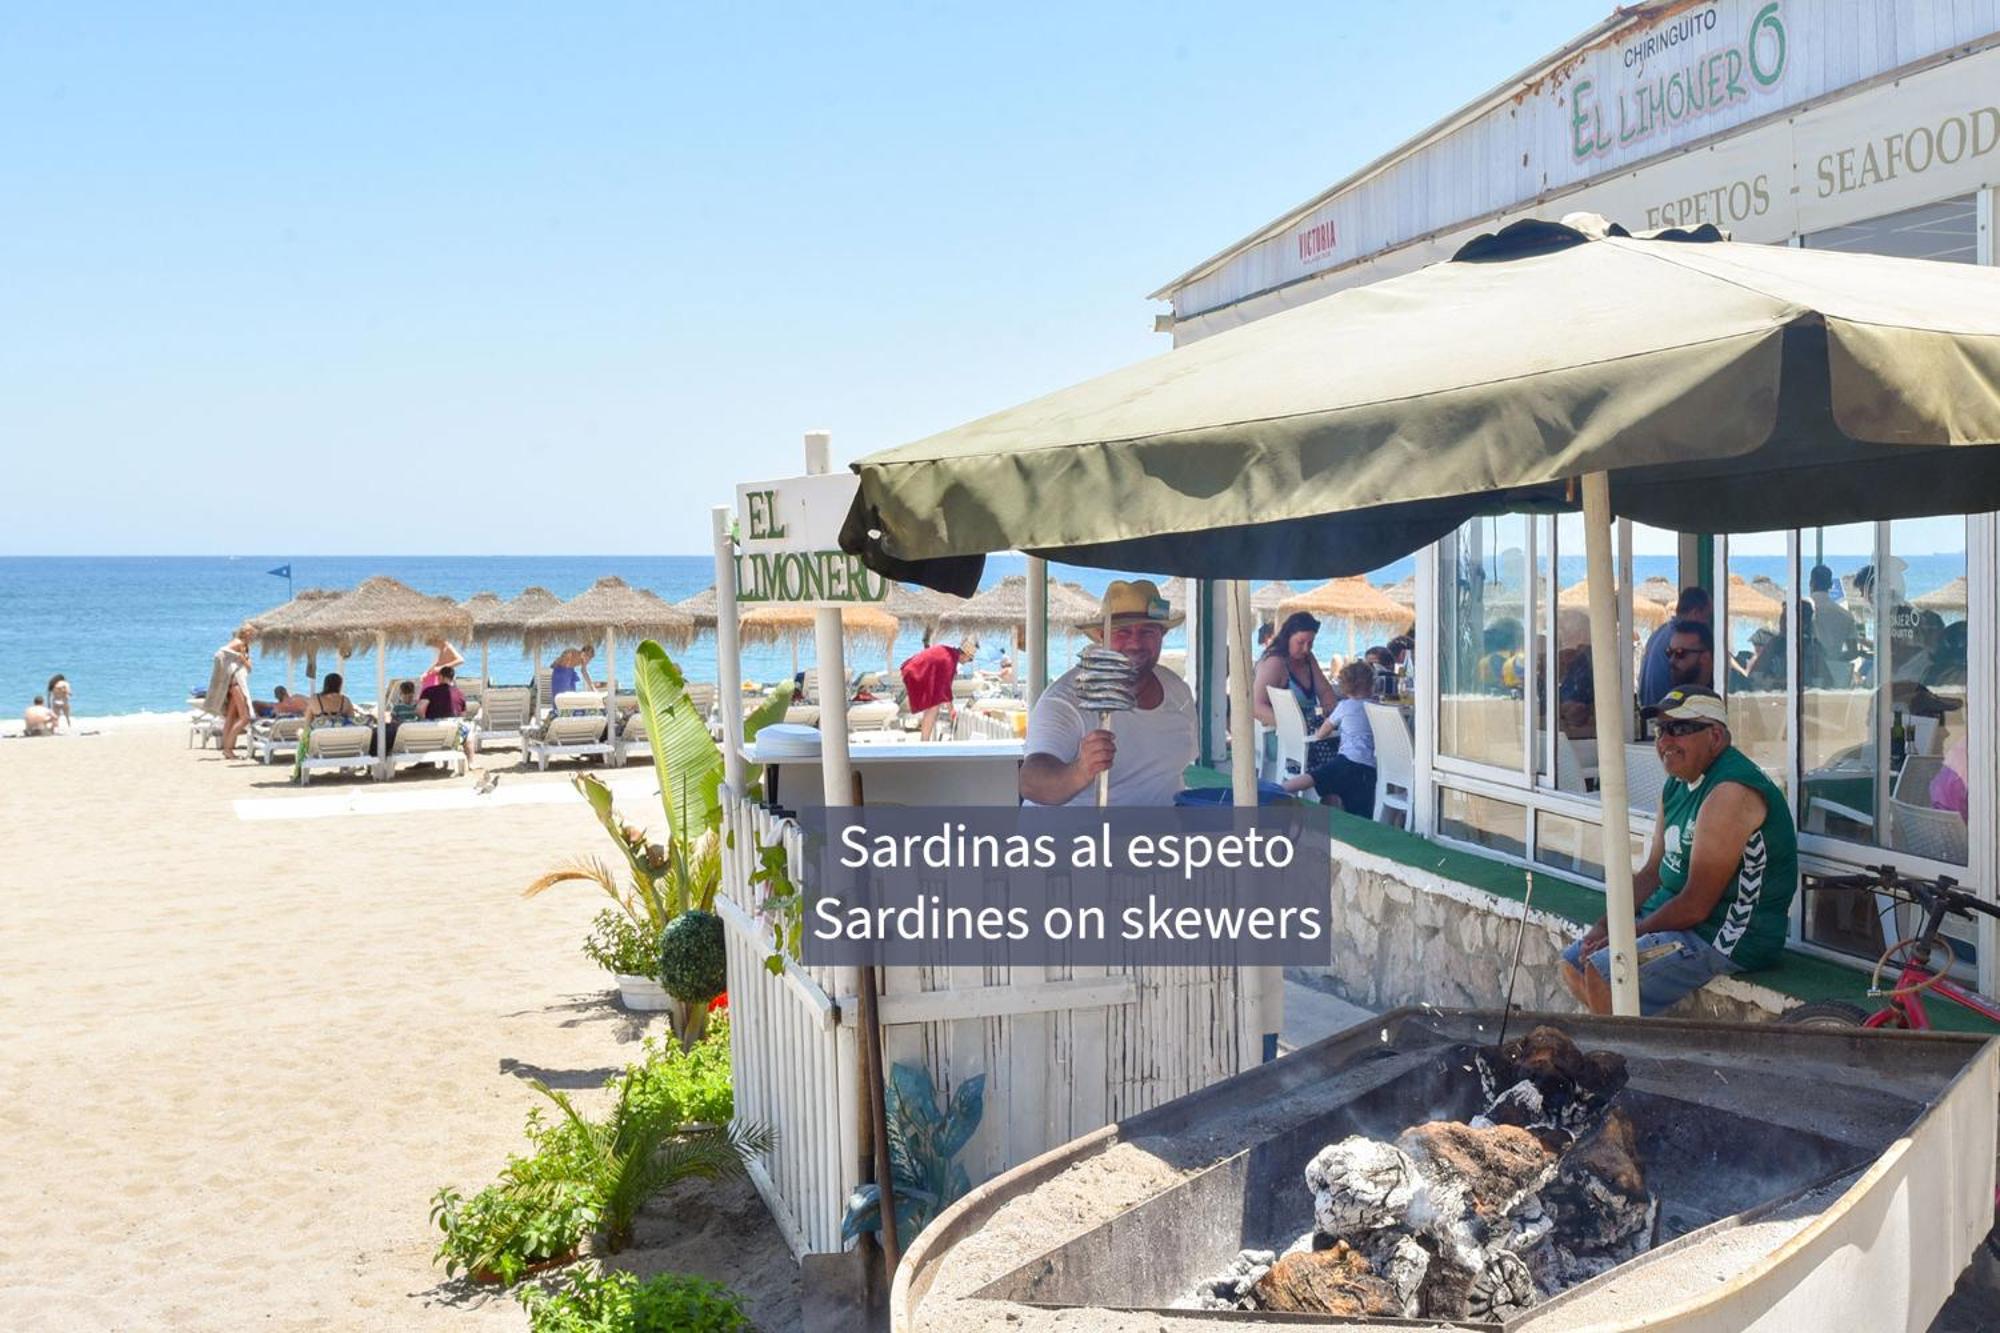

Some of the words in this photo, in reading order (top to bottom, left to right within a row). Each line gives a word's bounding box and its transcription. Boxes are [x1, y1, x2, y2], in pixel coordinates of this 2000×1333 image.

[1624, 9, 1717, 68] CHIRINGUITO
[1572, 81, 1612, 157] EL
[1619, 2, 1786, 141] LIMONERO
[1645, 174, 1770, 230] ESPETOS
[1817, 107, 2000, 198] SEAFOOD
[1298, 220, 1337, 260] VICTORIA
[746, 490, 785, 540] EL
[734, 550, 886, 602] LIMONERO
